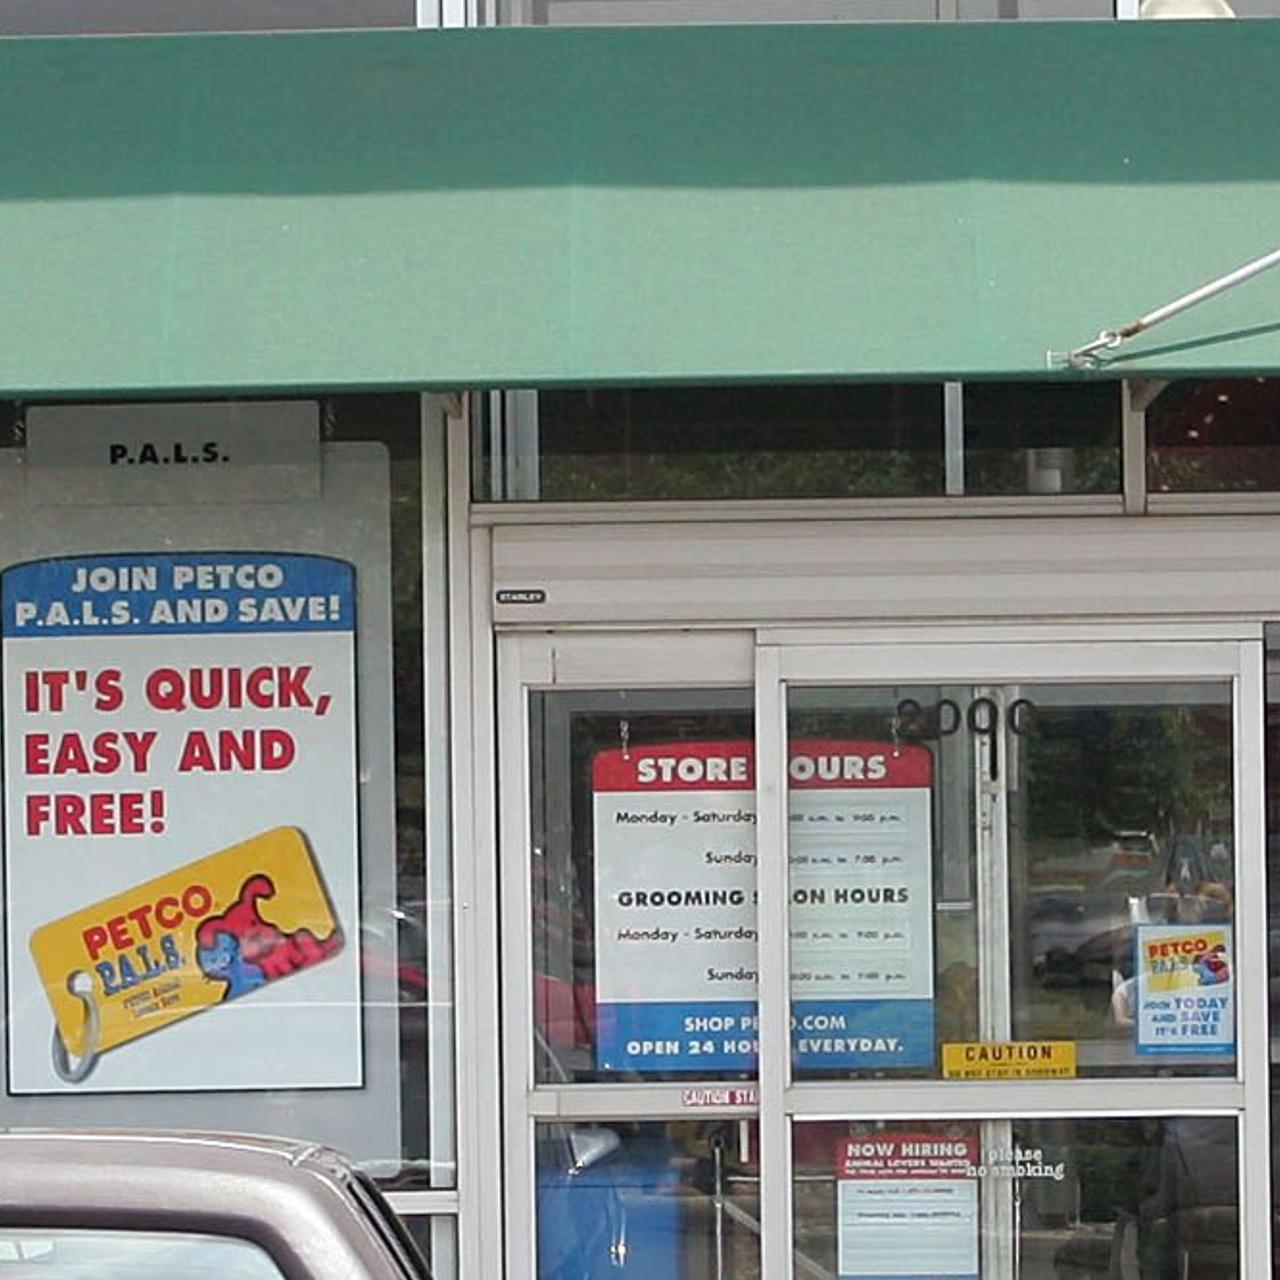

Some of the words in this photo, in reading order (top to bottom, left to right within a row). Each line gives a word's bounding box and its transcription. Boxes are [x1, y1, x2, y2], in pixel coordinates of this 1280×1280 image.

[111, 441, 231, 466] P.A.L.S.
[72, 566, 158, 594] JOIN
[174, 564, 284, 591] PETCO
[16, 598, 142, 626] P.A.L.S.
[149, 596, 229, 623] AND
[239, 595, 341, 622] SAVE!
[25, 670, 124, 713] IT'S
[145, 665, 333, 716] QUICK,
[25, 731, 158, 775] EASY
[178, 729, 296, 772] AND
[637, 757, 748, 783] STORE
[788, 755, 888, 781] OURS
[26, 790, 166, 836] FREE!
[616, 811, 678, 827] Monday
[617, 890, 745, 907] GROOMING
[834, 887, 910, 905] HOURS
[82, 884, 214, 961] PETCO
[618, 928, 679, 943] Monday
[1148, 938, 1208, 959] PETCO
[1174, 997, 1229, 1010] TODAY
[683, 1016, 735, 1033] SHOP
[741, 1015, 847, 1032] PE.COM
[1181, 1010, 1221, 1023] SAVE
[1181, 1023, 1218, 1037] FREE
[626, 1040, 681, 1056] OPEN
[687, 1039, 716, 1055] 24
[798, 1037, 905, 1053] EVERYDAY.
[965, 1045, 1053, 1062] CAUTION
[735, 1088, 758, 1105] STA
[847, 1142, 895, 1158] NOW
[900, 1142, 968, 1158] HIRING
[988, 1142, 1043, 1166] please
[992, 1160, 1065, 1181] smoking
